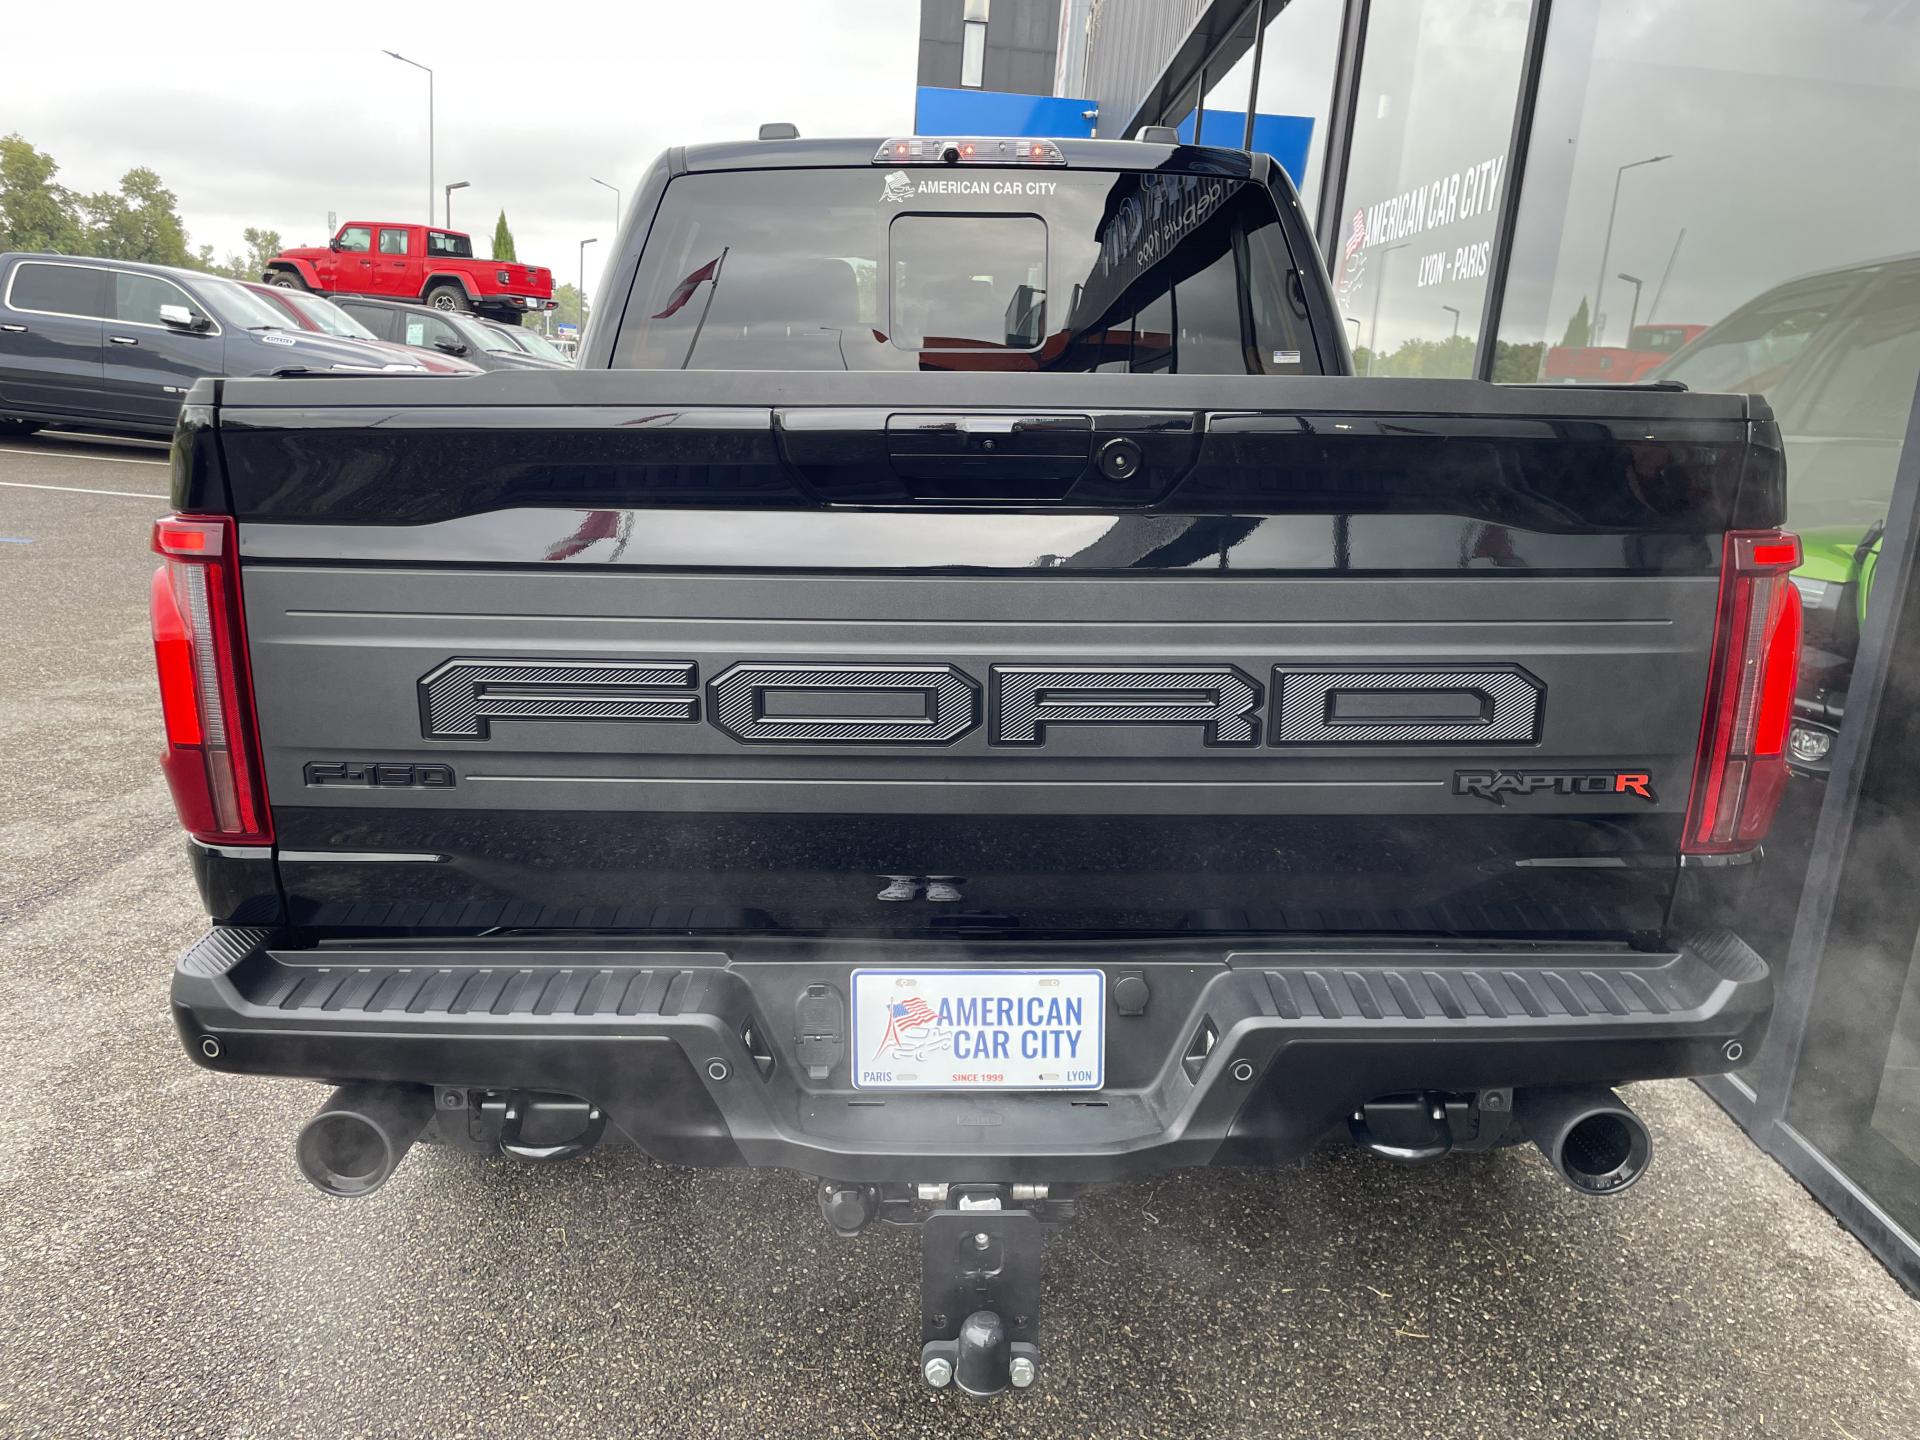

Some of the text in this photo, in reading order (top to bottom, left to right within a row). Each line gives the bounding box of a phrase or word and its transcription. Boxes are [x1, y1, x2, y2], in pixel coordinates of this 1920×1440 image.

[917, 180, 1057, 195] AMERICAN CAR CITY
[1362, 155, 1504, 249] AMERICAN CAR CITY
[1417, 251, 1446, 288] LYON
[1453, 240, 1490, 281] PARIS
[416, 656, 1548, 747] FORD
[303, 761, 456, 789] F-150
[1453, 770, 1657, 805] RAPTOR
[936, 996, 1083, 1027] AMERICAN
[953, 1030, 1083, 1060] CAR CITY
[863, 1071, 893, 1083] PARIS
[952, 1073, 1004, 1083] SINCE 1999
[1066, 1070, 1093, 1082] LYON
